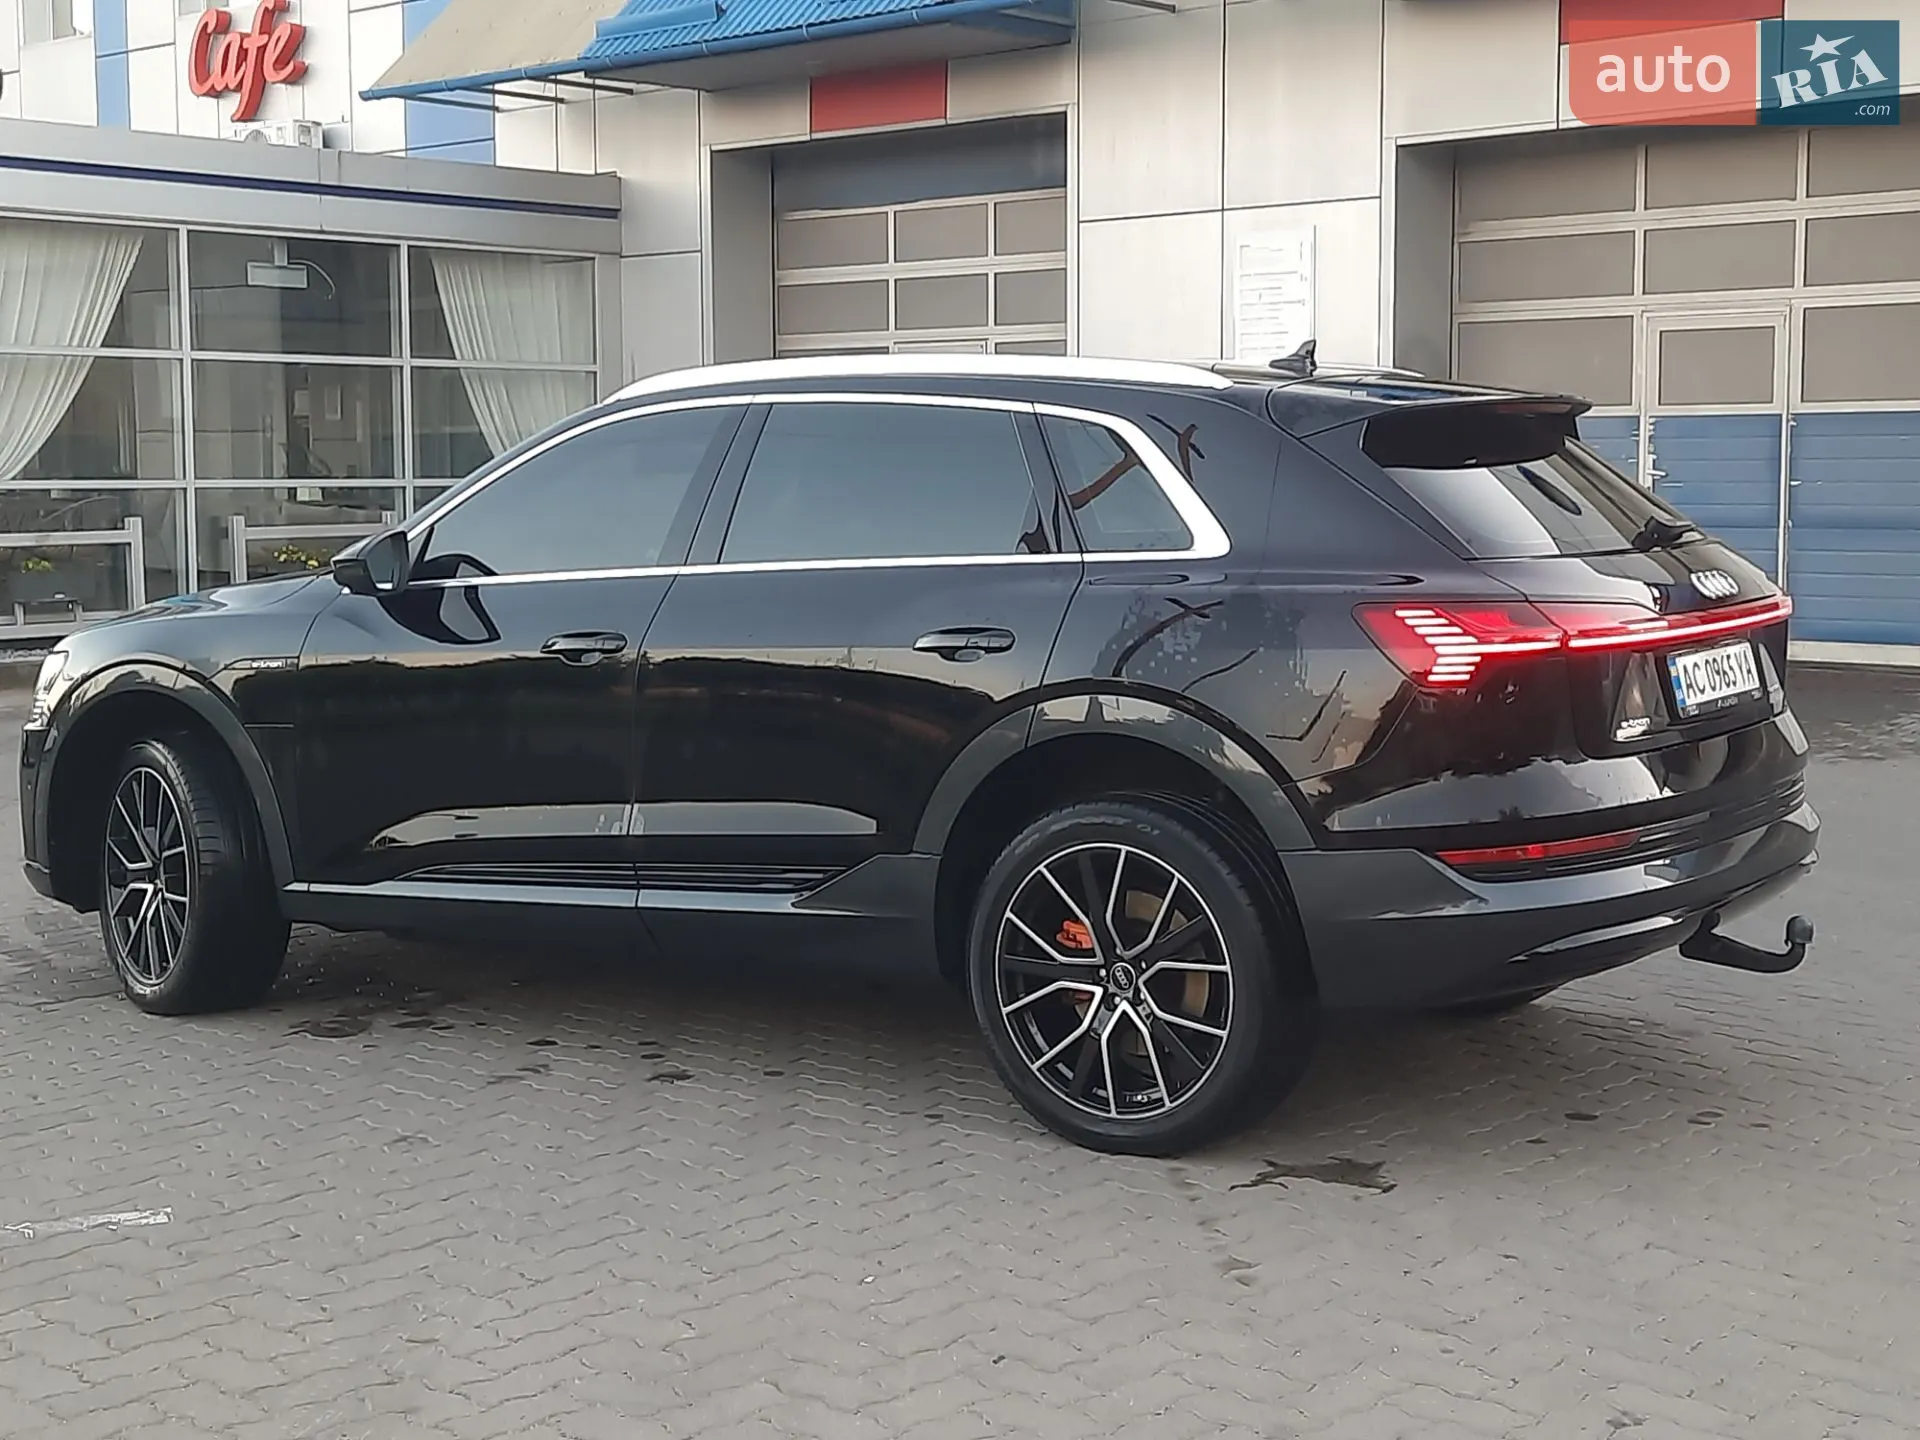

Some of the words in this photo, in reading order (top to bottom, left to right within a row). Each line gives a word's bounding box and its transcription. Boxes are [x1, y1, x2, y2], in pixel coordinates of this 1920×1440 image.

[188, 0, 307, 122] Cafe
[1682, 661, 1706, 700] AC
[1704, 652, 1738, 693] 0965
[1734, 649, 1756, 687] YA
